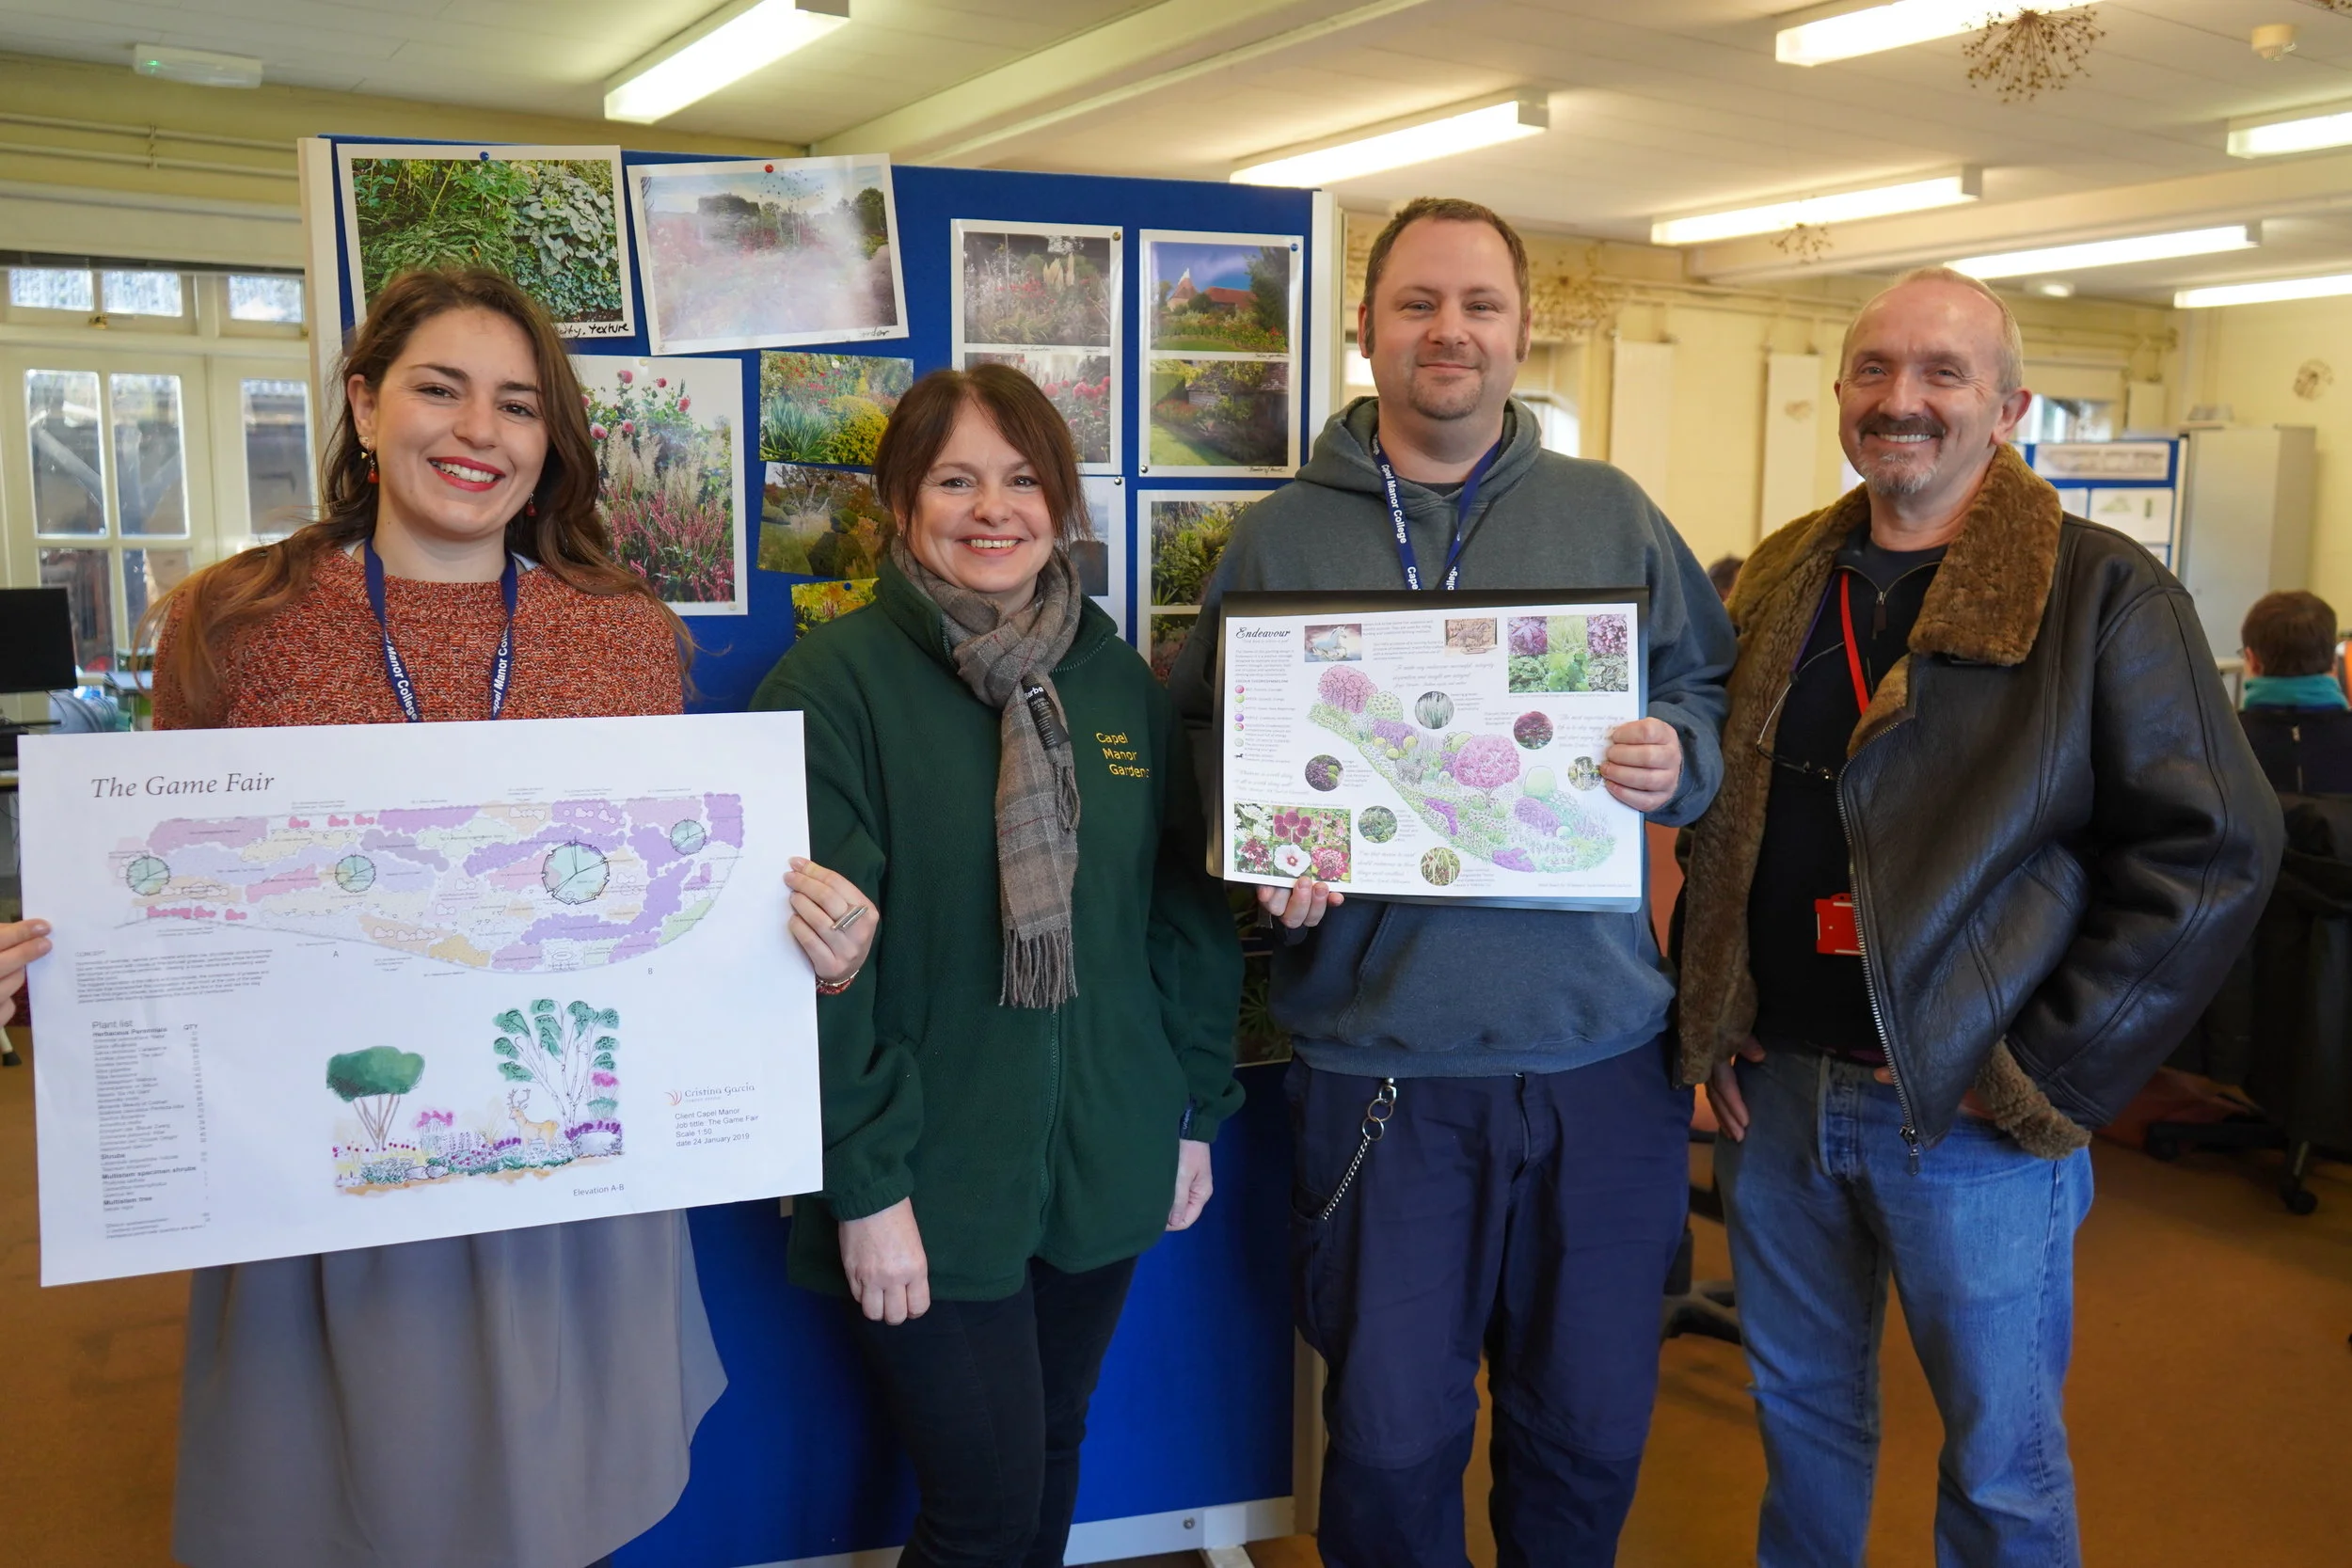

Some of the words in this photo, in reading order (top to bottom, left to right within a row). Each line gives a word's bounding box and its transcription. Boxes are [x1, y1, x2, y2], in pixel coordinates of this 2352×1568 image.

[1387, 480, 1400, 509] Manor
[1393, 509, 1407, 545] College
[1407, 566, 1421, 591] Cape
[1446, 566, 1458, 591] olleg
[1235, 626, 1291, 640] Endeavour
[494, 658, 508, 690] Manor
[387, 645, 404, 678] Manor
[397, 679, 418, 721] College
[1095, 732, 1128, 745] Capel
[1102, 748, 1137, 761] Manor
[90, 776, 137, 798] The
[146, 775, 217, 796] Game
[225, 771, 275, 792] Fair
[91, 1021, 118, 1029] Plant
[684, 1086, 723, 1098] Cristina
[696, 1110, 717, 1118] Capel
[723, 1116, 744, 1124] Game
[675, 1130, 695, 1138] Scale
[675, 1139, 691, 1148] date
[704, 1135, 731, 1144] January
[732, 1132, 750, 1141] 2019
[573, 1185, 610, 1196] Elevation
[611, 1183, 625, 1192] A-B
